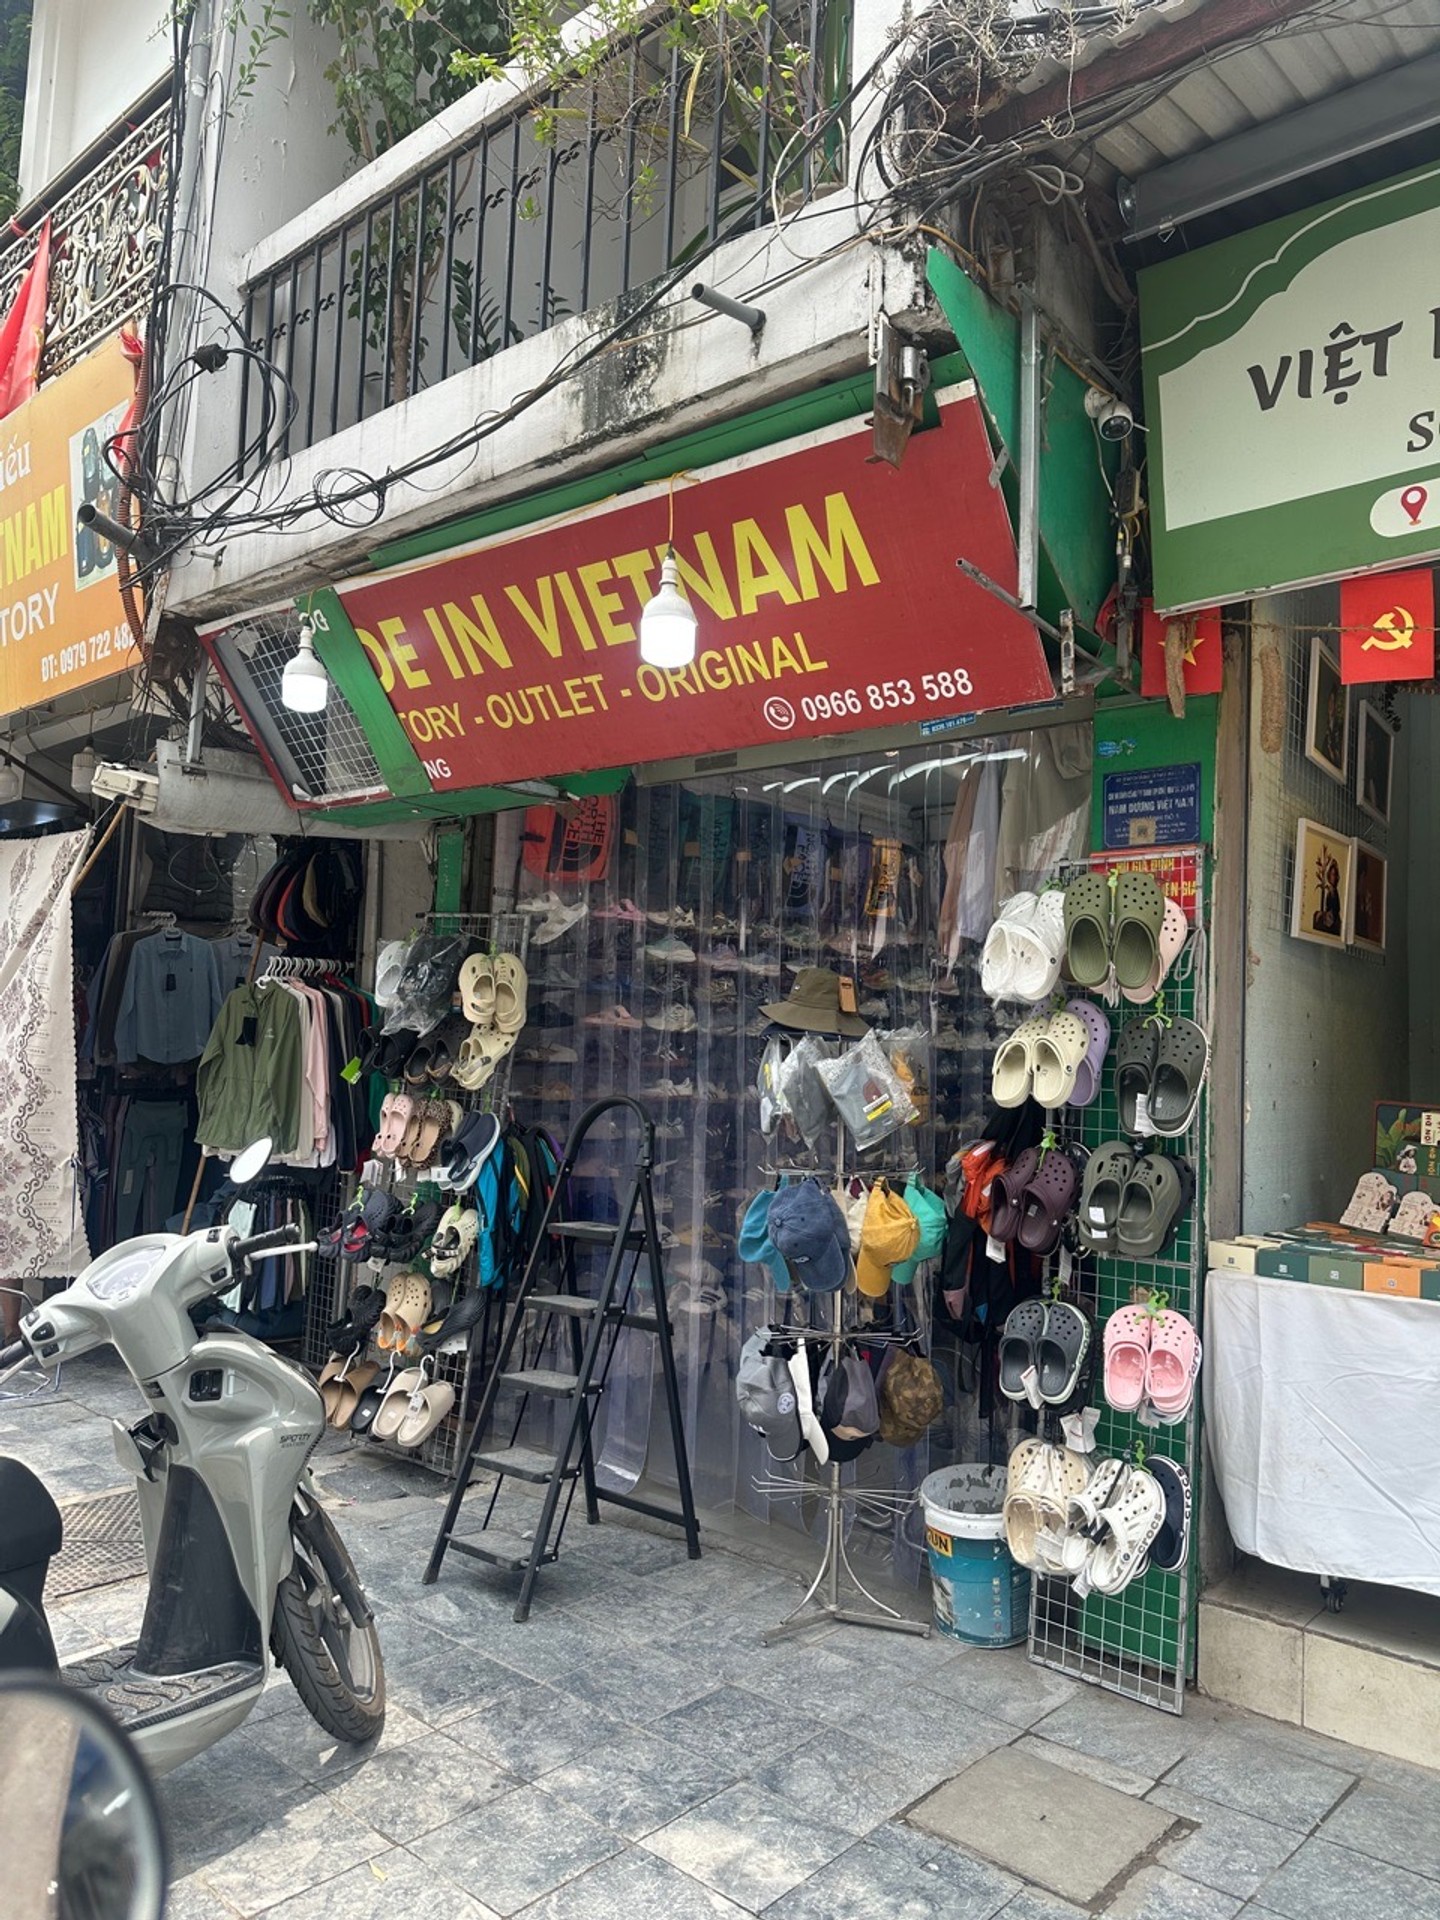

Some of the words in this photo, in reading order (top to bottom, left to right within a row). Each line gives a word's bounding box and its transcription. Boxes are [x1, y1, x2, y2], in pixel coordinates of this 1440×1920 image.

[1247, 320, 1404, 411] VIỆT
[1407, 411, 1440, 452] S
[0, 484, 68, 588] NAM
[423, 594, 513, 680] IN
[504, 492, 881, 658] VIETNAM
[60, 640, 88, 675] 0979
[89, 630, 112, 662] 722
[398, 702, 466, 742] ORY
[486, 674, 609, 729] OUTLET
[637, 632, 828, 702] ORIGINAL
[801, 689, 862, 722] 0966
[866, 679, 916, 711] 853
[922, 668, 974, 701] 588
[1138, 1512, 1162, 1554] crocs
